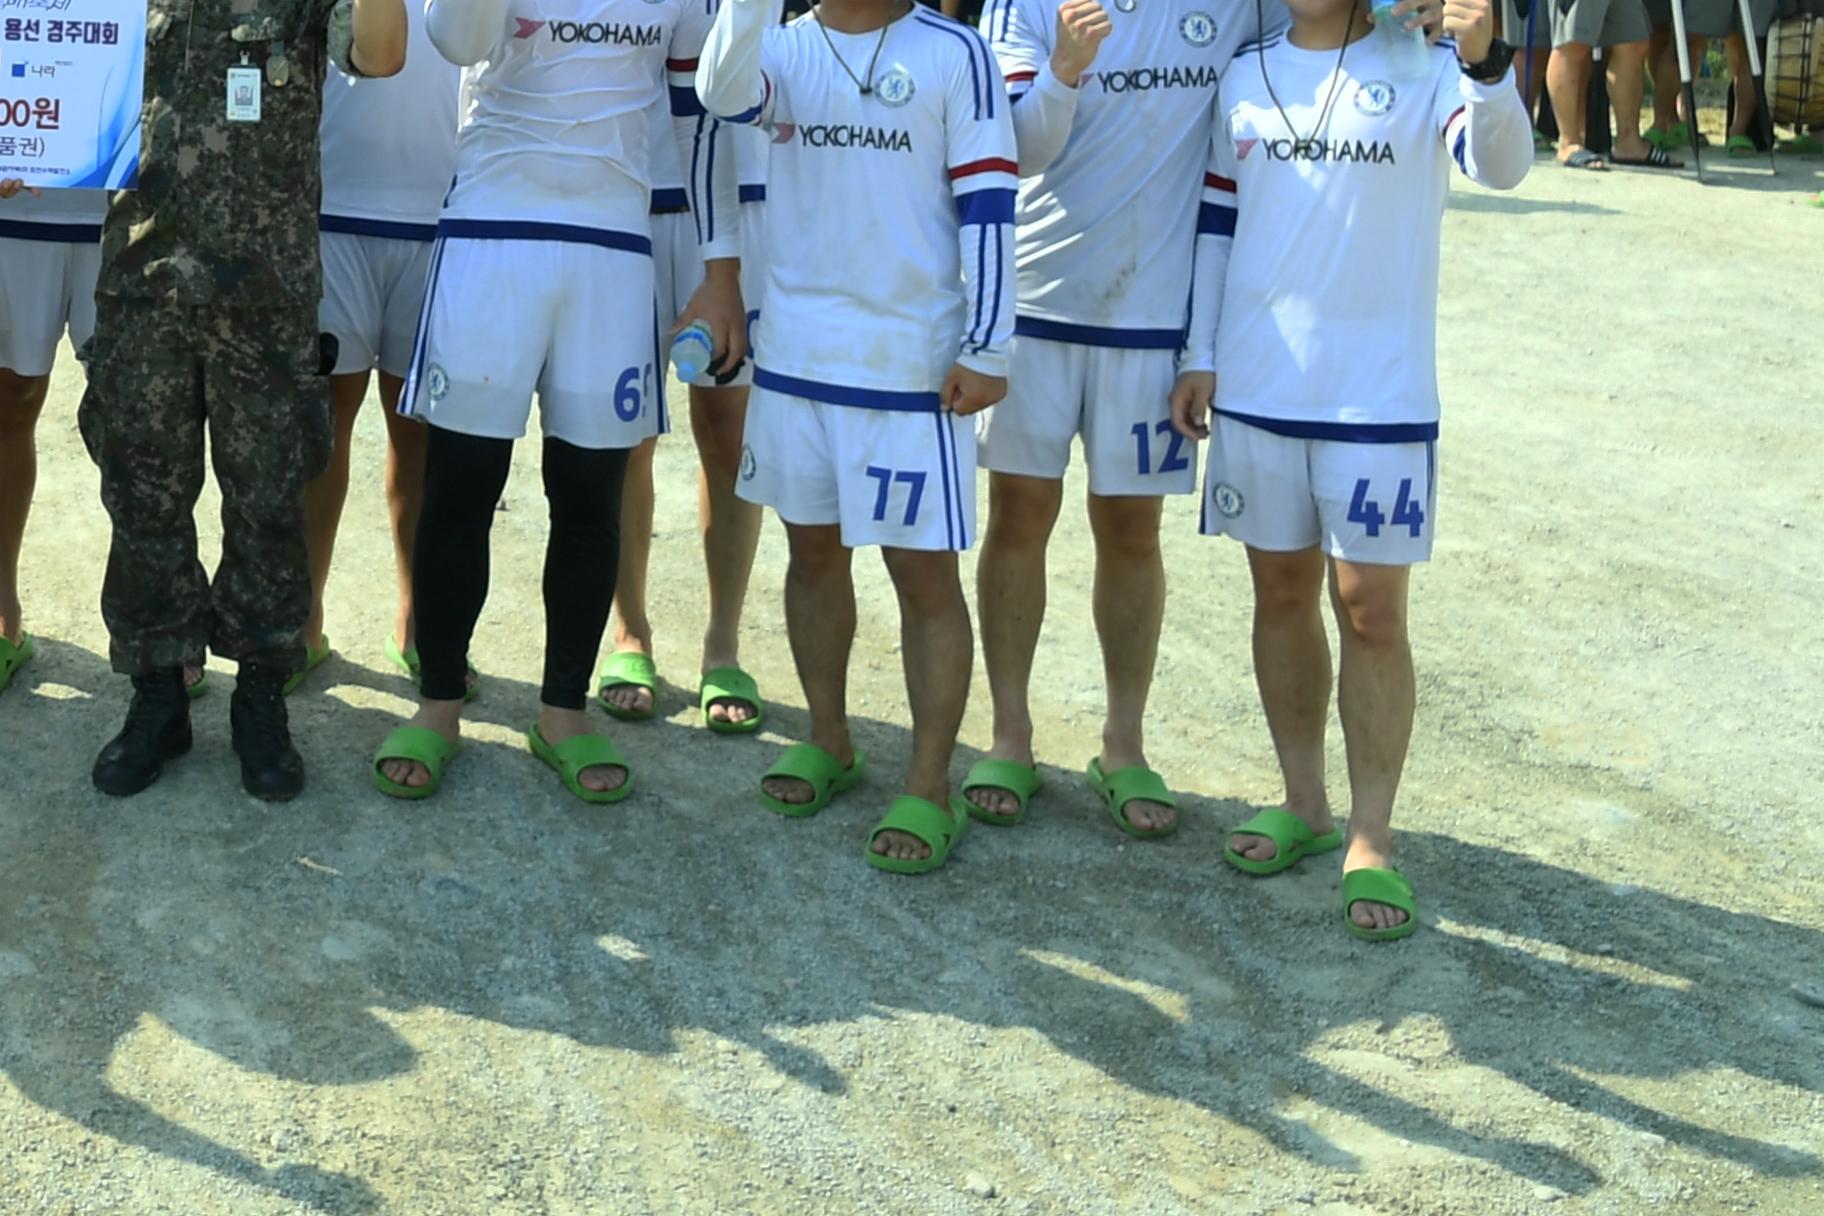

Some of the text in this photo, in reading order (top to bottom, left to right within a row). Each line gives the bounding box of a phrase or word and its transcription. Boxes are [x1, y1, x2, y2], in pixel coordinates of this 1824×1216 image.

[4, 18, 41, 42] 용선
[47, 20, 119, 45] 경주대회
[548, 20, 662, 47] YOKOHAMA
[30, 62, 56, 79] 나라
[1097, 65, 1218, 94] YOKOHAMA
[798, 123, 913, 154] YOKOHAMA
[1262, 137, 1396, 165] YOKOHAMA
[1130, 417, 1190, 475] 12
[865, 465, 928, 527] 77
[1346, 477, 1425, 538] 44
